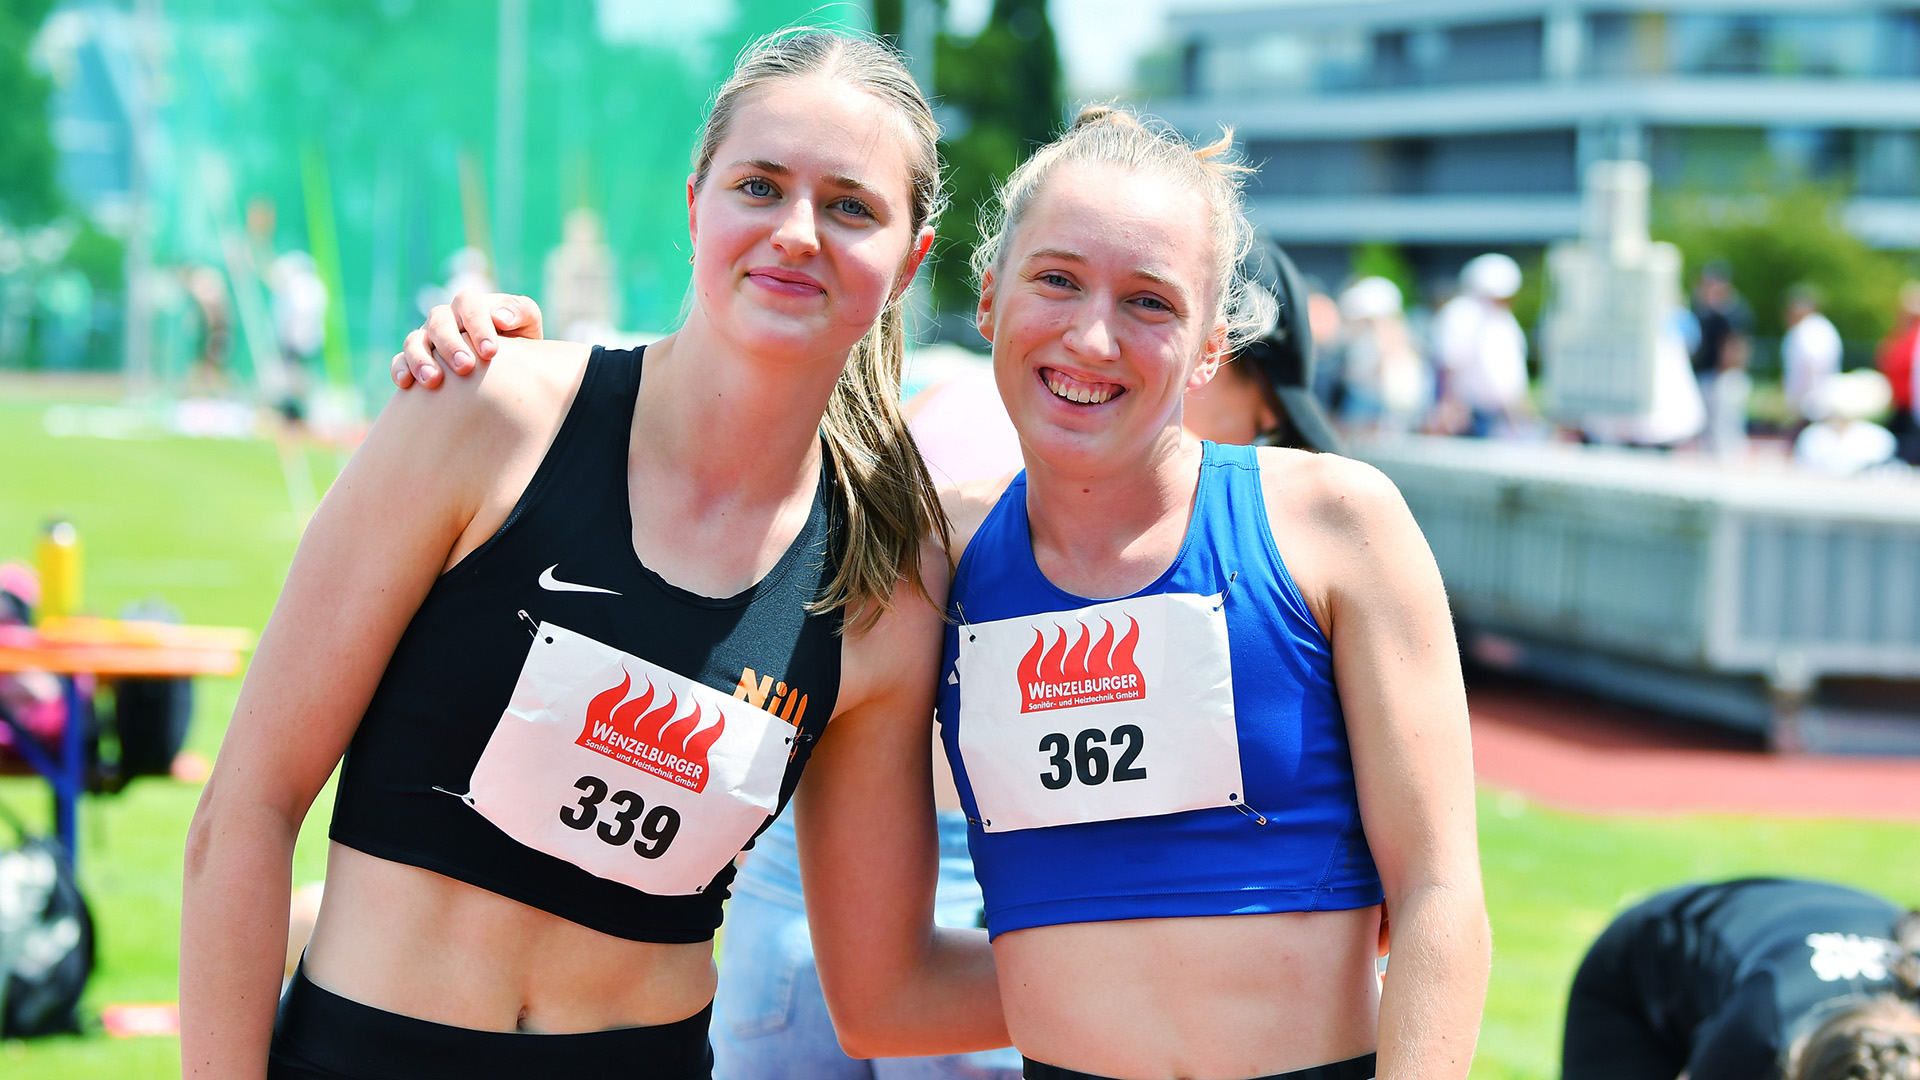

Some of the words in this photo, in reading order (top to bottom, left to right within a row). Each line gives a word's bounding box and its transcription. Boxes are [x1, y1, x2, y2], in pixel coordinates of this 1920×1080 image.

[1028, 674, 1138, 700] WENZELBURGER
[1028, 700, 1057, 711] Sanitär-
[1059, 698, 1073, 707] und
[1074, 693, 1115, 705] Heiztechnik
[1115, 690, 1139, 700] GmbH
[585, 739, 615, 756] Sanitär-
[616, 752, 632, 763] und
[632, 757, 674, 780] Heiztechnik
[674, 776, 698, 789] GmbH
[592, 720, 704, 780] WENZELBURGER
[1038, 724, 1147, 790] 362
[559, 775, 681, 859] 339
